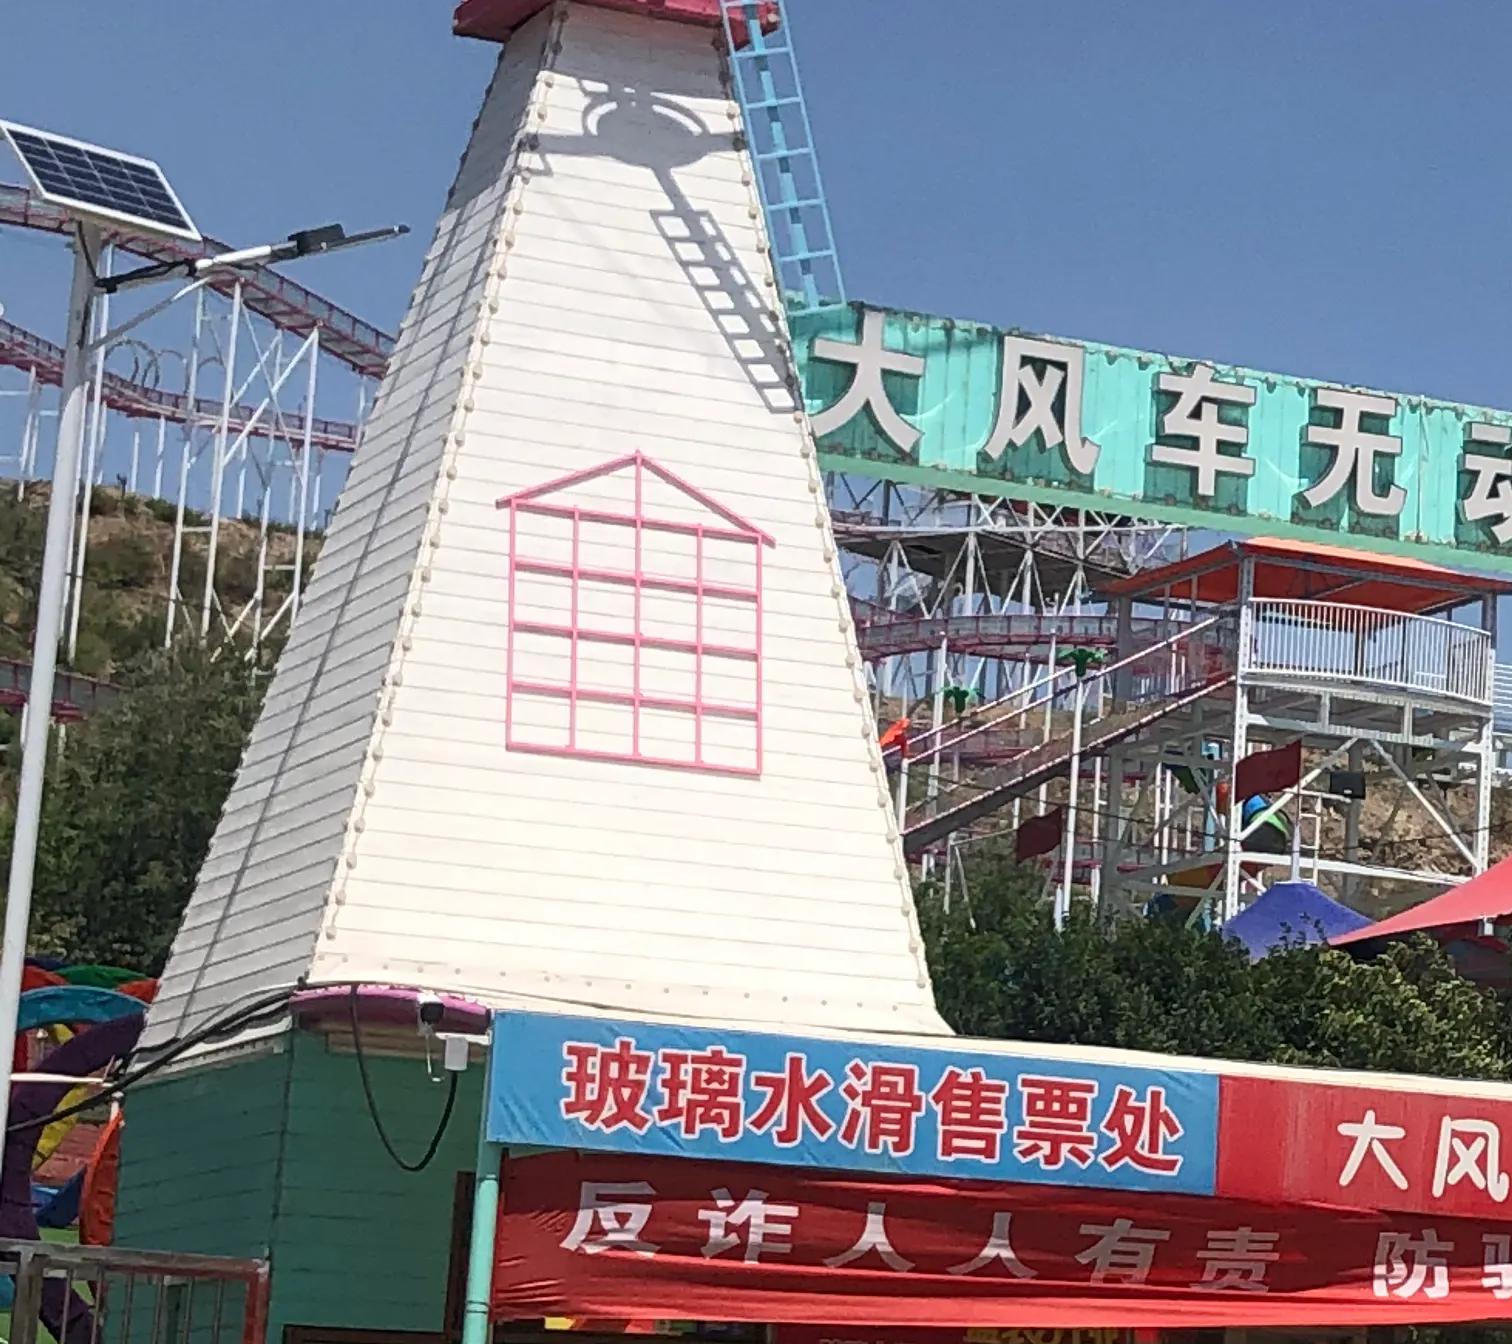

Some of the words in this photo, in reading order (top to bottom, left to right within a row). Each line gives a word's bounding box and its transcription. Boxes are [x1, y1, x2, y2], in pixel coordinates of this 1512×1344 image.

[562, 1035, 1185, 1176] 玻璃水滑售票处
[560, 1179, 1282, 1294] 反诈人人有责
